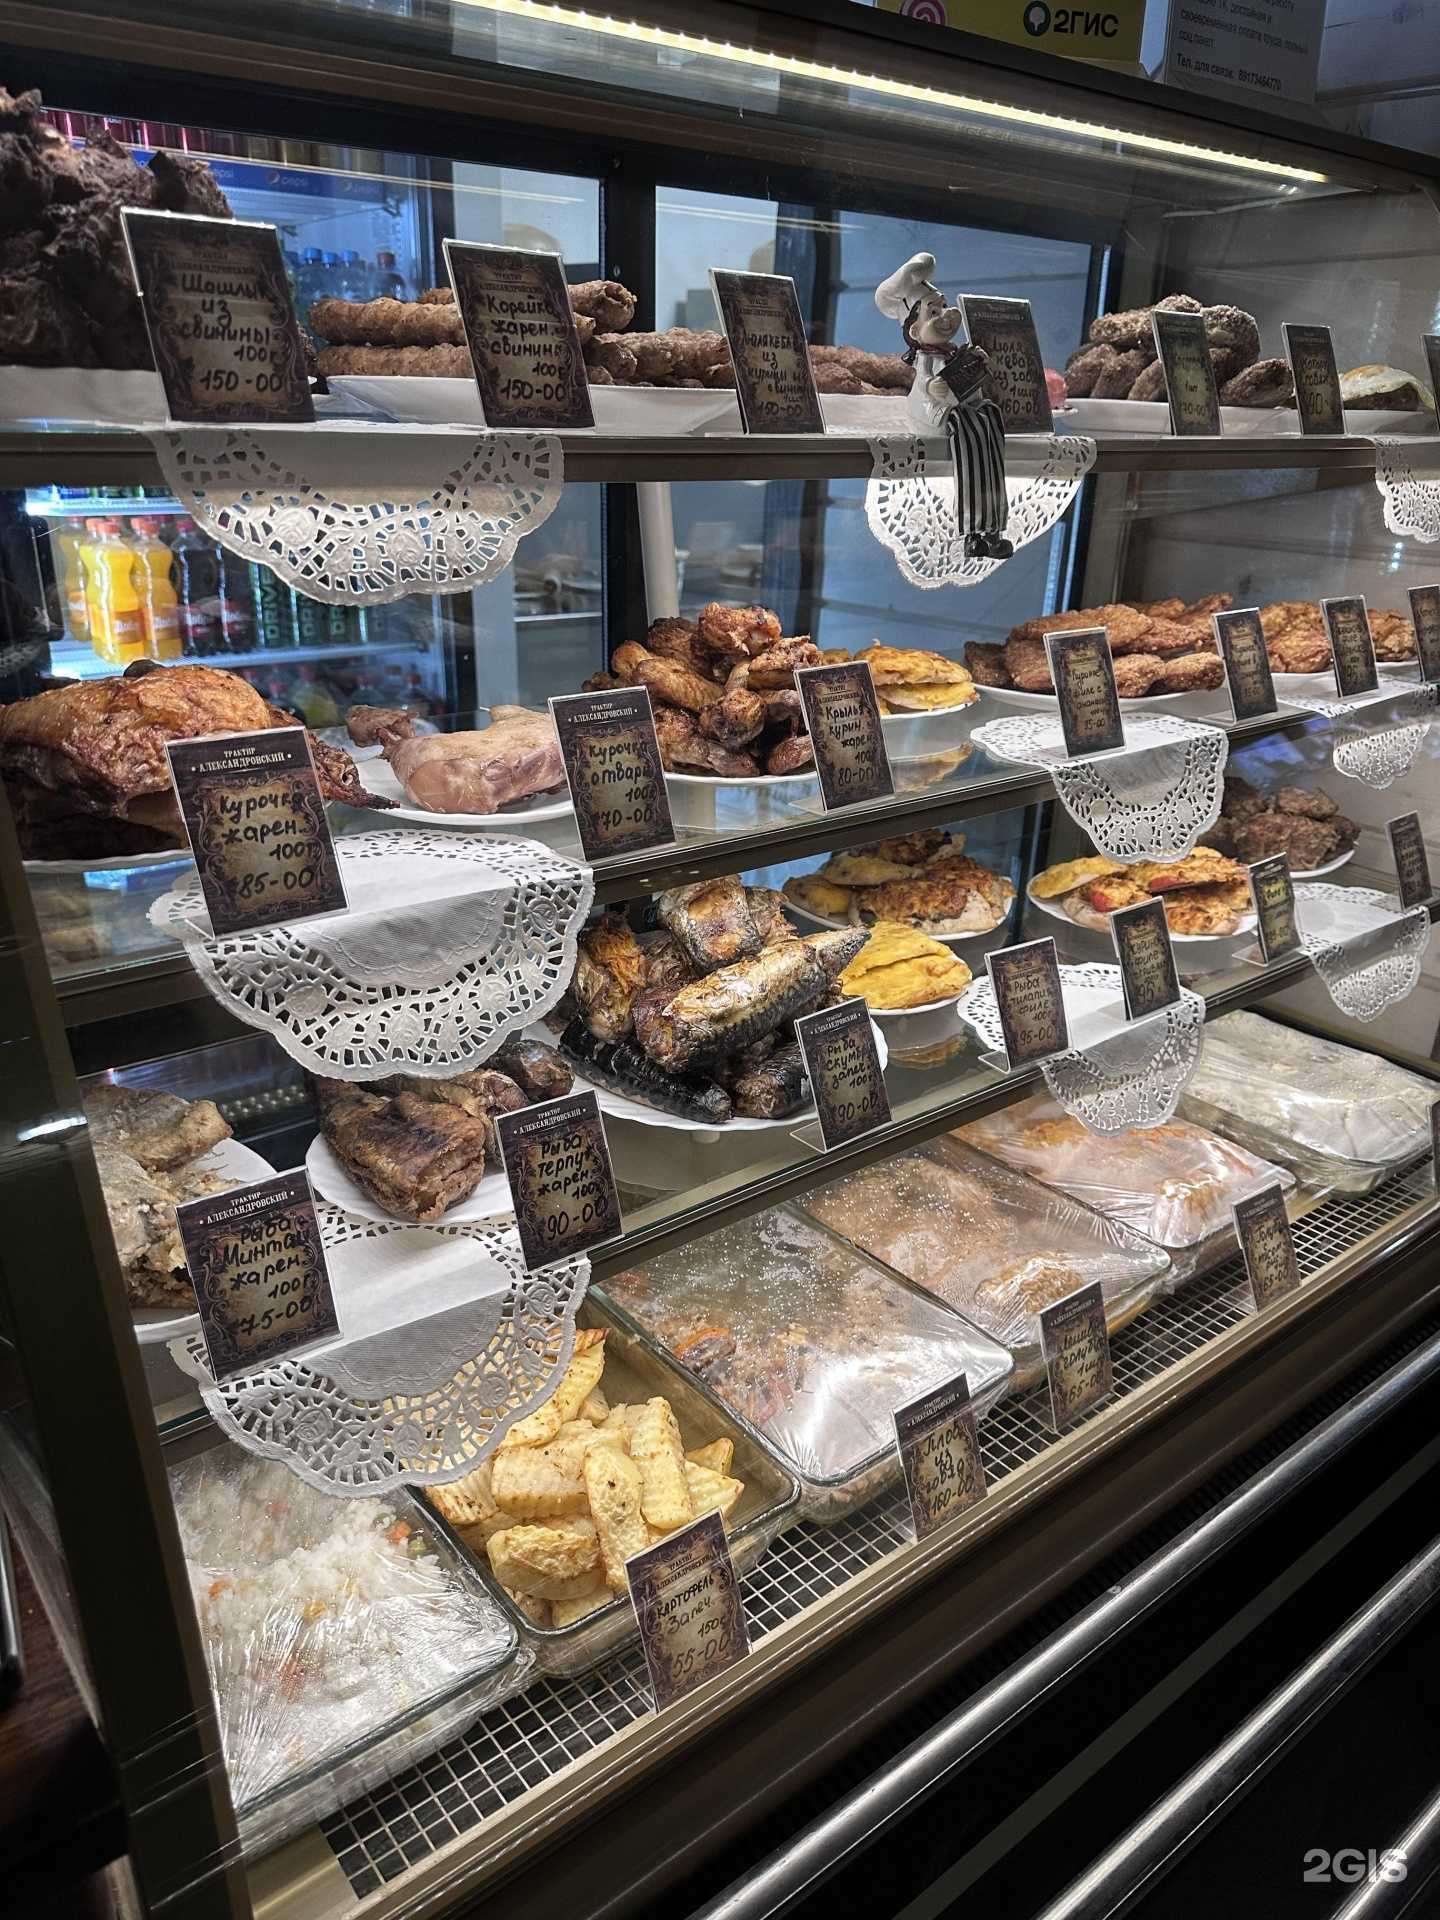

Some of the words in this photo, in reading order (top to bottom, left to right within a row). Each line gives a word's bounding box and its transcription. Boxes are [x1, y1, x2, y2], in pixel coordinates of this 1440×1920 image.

[1053, 9, 1119, 38] 2ГИС
[201, 299, 232, 327] из
[200, 368, 284, 393] 150-00
[501, 378, 567, 401] 150-00
[199, 752, 285, 773] АЛЕКСАНДРОВСКИЙ
[224, 747, 256, 759] ТРАКТИР
[238, 867, 315, 899] 85-00
[207, 1191, 288, 1225] АЛЕКСАНДРОВСКИЙ
[231, 1190, 261, 1206] ТРАКТИР
[547, 1201, 606, 1242] 90-00
[240, 1296, 313, 1336] 75-00
[656, 1573, 714, 1619] КАРТОФЕЛЬ
[671, 1633, 730, 1679] 55-00
